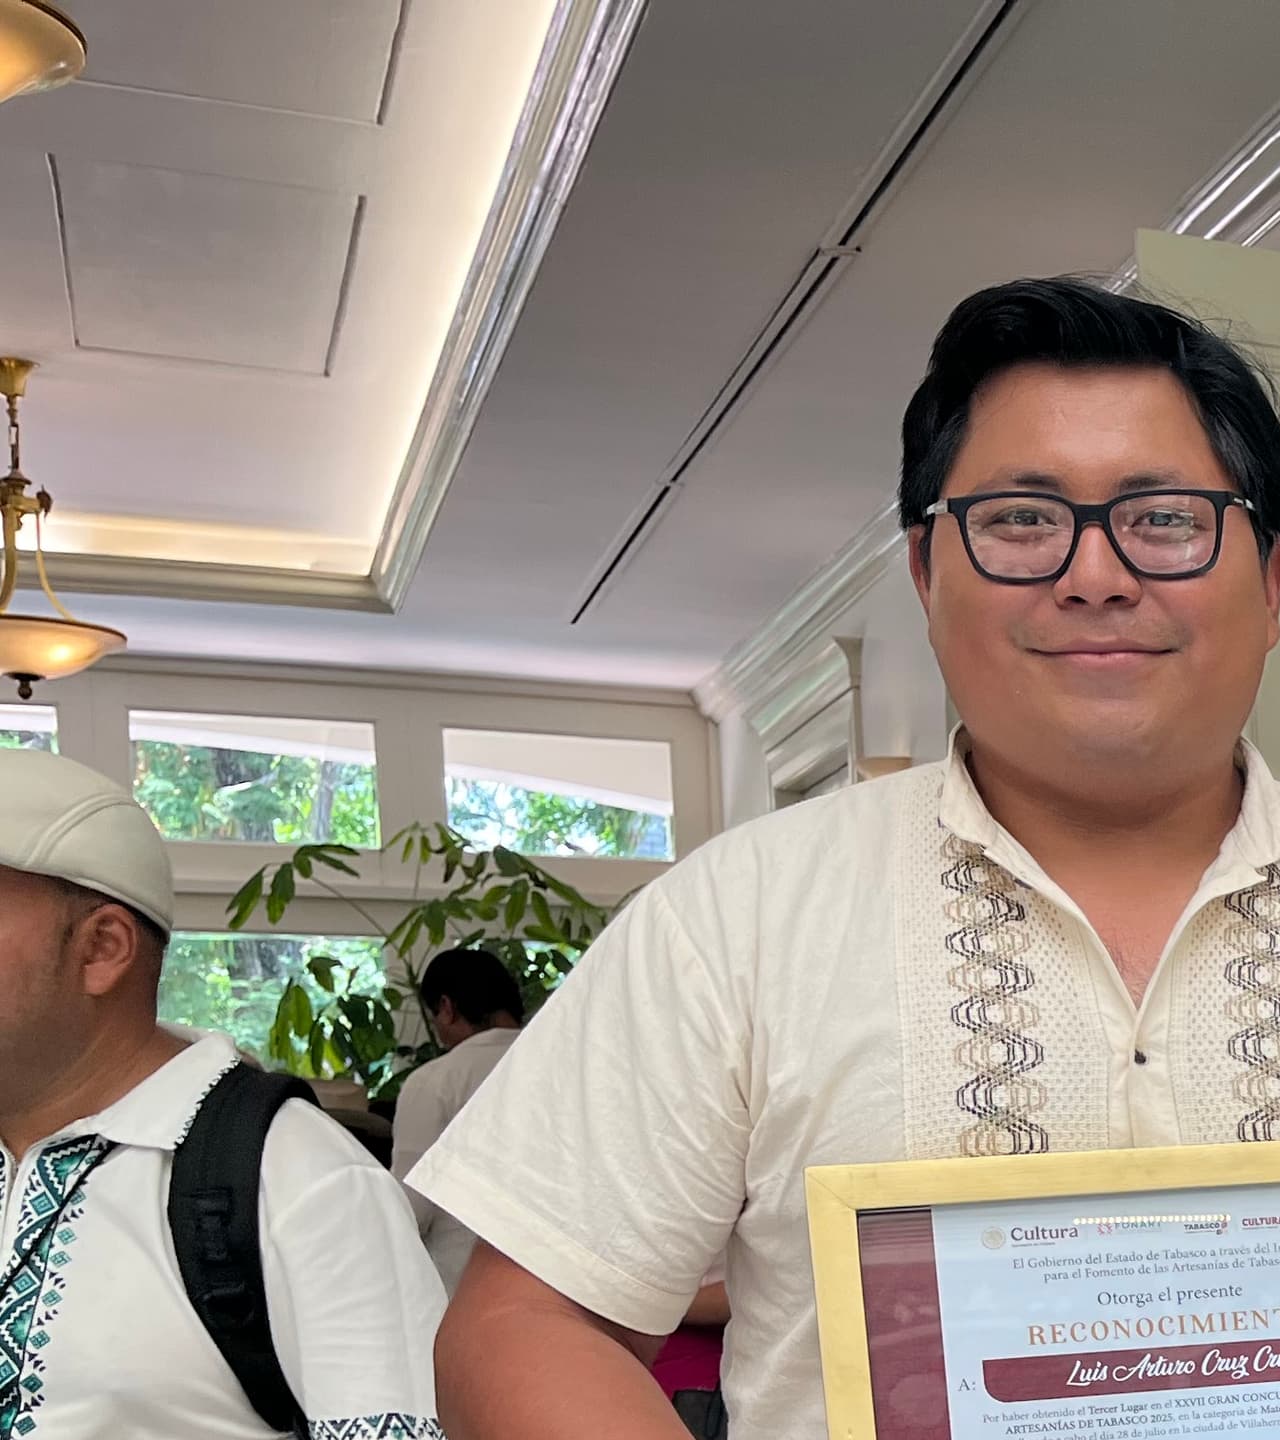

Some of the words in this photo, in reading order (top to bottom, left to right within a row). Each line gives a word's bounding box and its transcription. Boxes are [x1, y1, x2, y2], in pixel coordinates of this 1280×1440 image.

[1010, 1226, 1079, 1241] Cultura
[1184, 1222, 1221, 1231] TABASCO
[1013, 1258, 1025, 1269] El
[1028, 1255, 1082, 1269] Gobierno
[1085, 1254, 1101, 1265] del
[1105, 1251, 1143, 1264] Estado
[1146, 1249, 1160, 1261] de
[1164, 1247, 1207, 1260] Tabasco
[1219, 1244, 1251, 1257] través
[1253, 1243, 1270, 1255] del
[1043, 1272, 1069, 1283] para
[1072, 1268, 1082, 1279] el
[1085, 1266, 1135, 1278] Fomento
[1138, 1264, 1151, 1275] de
[1154, 1261, 1169, 1273] las
[1232, 1258, 1246, 1269] de
[1097, 1290, 1152, 1308] Otorga
[1158, 1287, 1171, 1301] el
[1177, 1285, 1243, 1305] presente
[957, 1378, 976, 1392] A:
[1066, 1359, 1108, 1387] Luis
[1112, 1353, 1196, 1382] Arturo
[1201, 1348, 1250, 1380] Cruz
[982, 1414, 999, 1424] Por
[1002, 1411, 1029, 1422] haber
[1031, 1408, 1075, 1420] obtenido
[1077, 1406, 1086, 1416] el
[1088, 1404, 1118, 1415] Tercer
[1120, 1403, 1148, 1416] Lugar
[1150, 1402, 1162, 1410] en
[1164, 1400, 1173, 1409] el
[1175, 1396, 1206, 1409] XXVII
[1207, 1394, 1240, 1406] GRAN
[1005, 1418, 1076, 1435] ARTESANÍAS
[1079, 1419, 1094, 1429] DE
[1096, 1415, 1148, 1428] TABASCO
[1150, 1414, 1175, 1424] 2025,
[1178, 1413, 1190, 1421] en
[1192, 1411, 1201, 1420] la
[1247, 1407, 1258, 1415] de
[1117, 1430, 1128, 1439] 28
[1131, 1428, 1142, 1438] de
[1144, 1426, 1166, 1439] julio
[1168, 1426, 1180, 1434] en
[1182, 1423, 1191, 1433] la
[1193, 1421, 1224, 1433] ciudad
[1226, 1420, 1238, 1430] de
